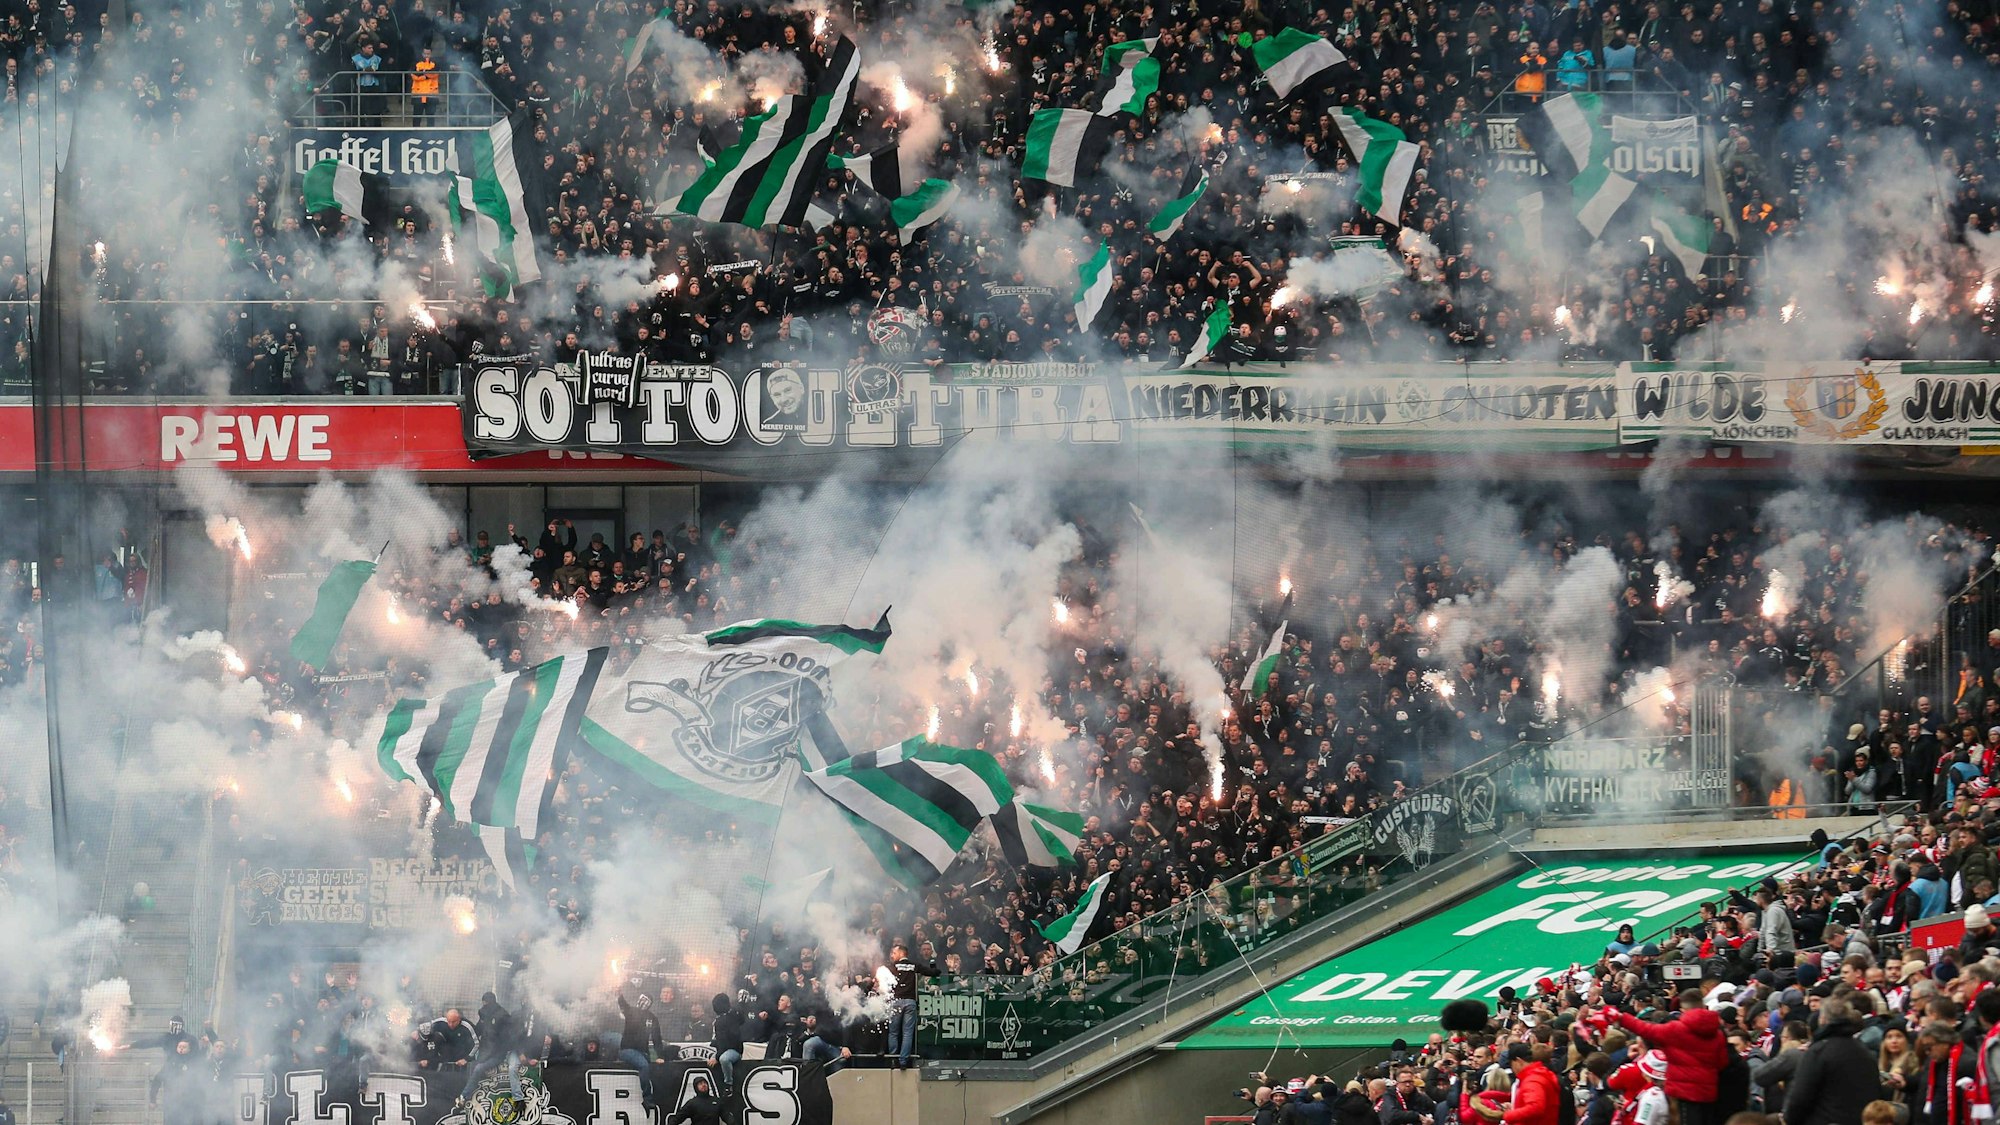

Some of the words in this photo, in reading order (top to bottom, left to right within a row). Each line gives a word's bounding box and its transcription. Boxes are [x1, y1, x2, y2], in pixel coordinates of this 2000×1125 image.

[590, 351, 633, 369] ultras
[594, 386, 628, 402] nord
[1633, 372, 1768, 424] WILDE
[1902, 377, 2000, 424] JUN
[856, 399, 896, 412] ULTRAS
[161, 414, 332, 461] REWE
[1713, 424, 1799, 441] MÖNCHEN
[1883, 424, 1968, 441] GLADBACH
[1374, 793, 1452, 845] CUSTODES
[1309, 832, 1359, 864] Gummersbach
[1517, 864, 1712, 889] Come
[284, 885, 361, 905] GEHT
[281, 903, 366, 923] EINIGES
[1452, 888, 1724, 934] FC!
[1005, 1017, 1016, 1031] 15
[1333, 1015, 1398, 1024] Getan.
